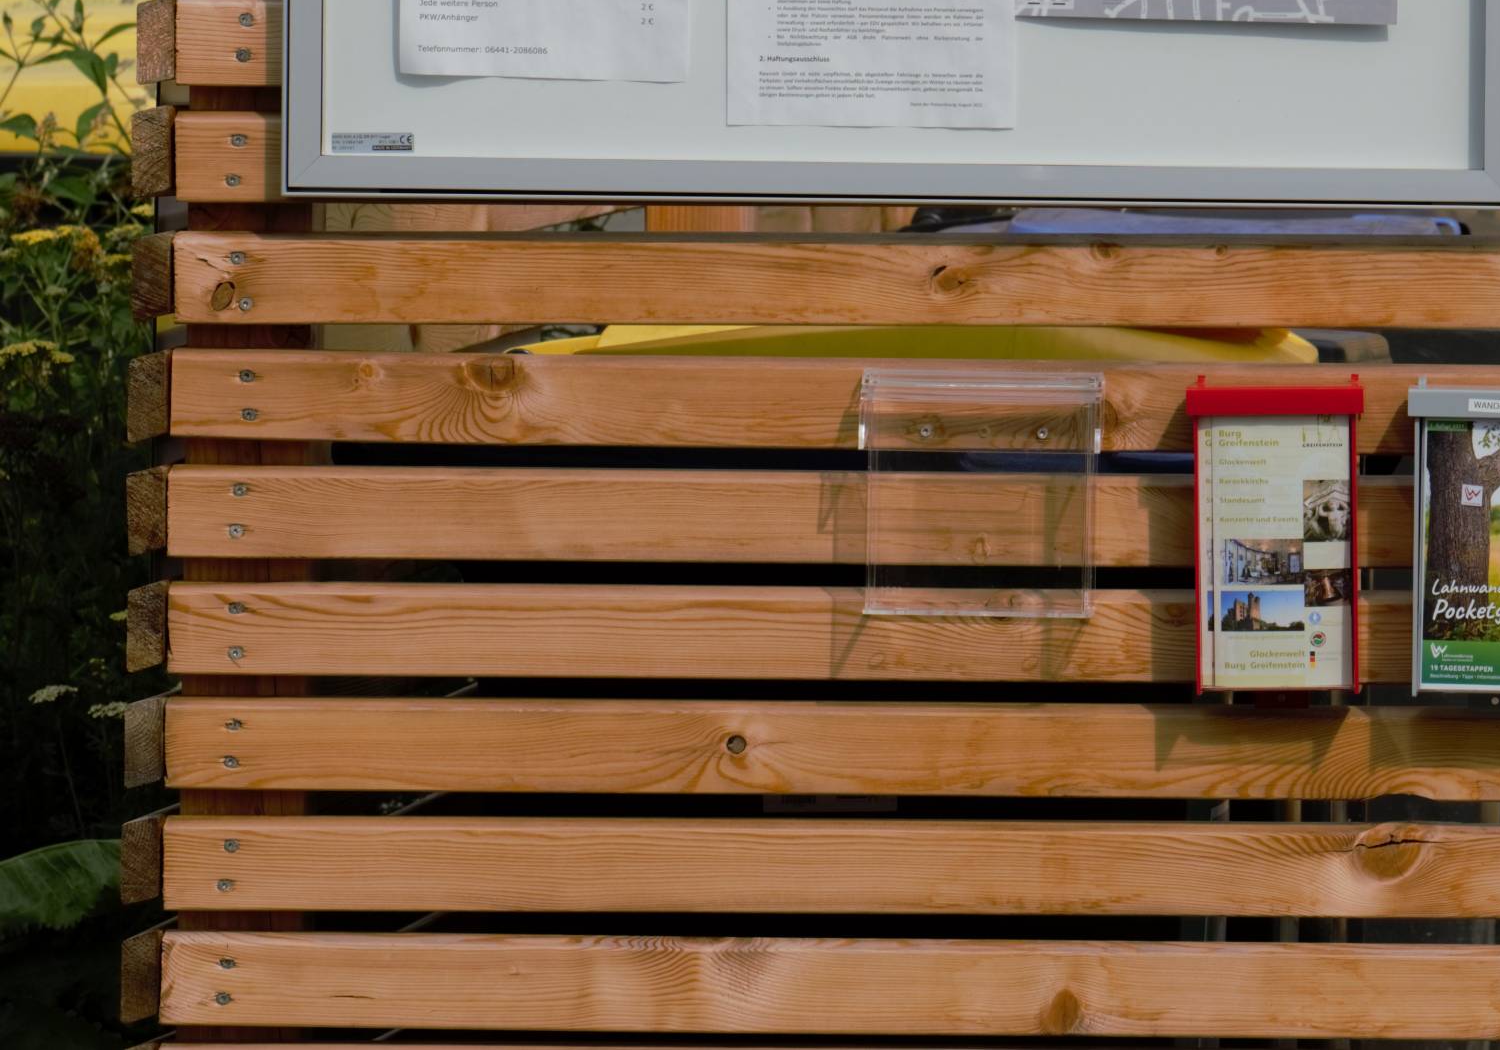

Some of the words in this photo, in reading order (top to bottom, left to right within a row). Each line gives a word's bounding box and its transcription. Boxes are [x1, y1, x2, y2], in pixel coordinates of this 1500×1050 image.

[471, 0, 498, 8] Person
[419, 13, 479, 22] PKW/Anhänger
[418, 45, 482, 53] Telefonnummer:
[767, 55, 830, 64] Haftungsausschluss
[1218, 430, 1242, 439] Burg
[1218, 438, 1280, 447] Greifenstein
[1249, 650, 1305, 658] Glockenwelt
[1224, 662, 1246, 671] Burg
[1250, 662, 1306, 670] Greifenstein
[1440, 664, 1494, 672] TAGESETAPPEN
